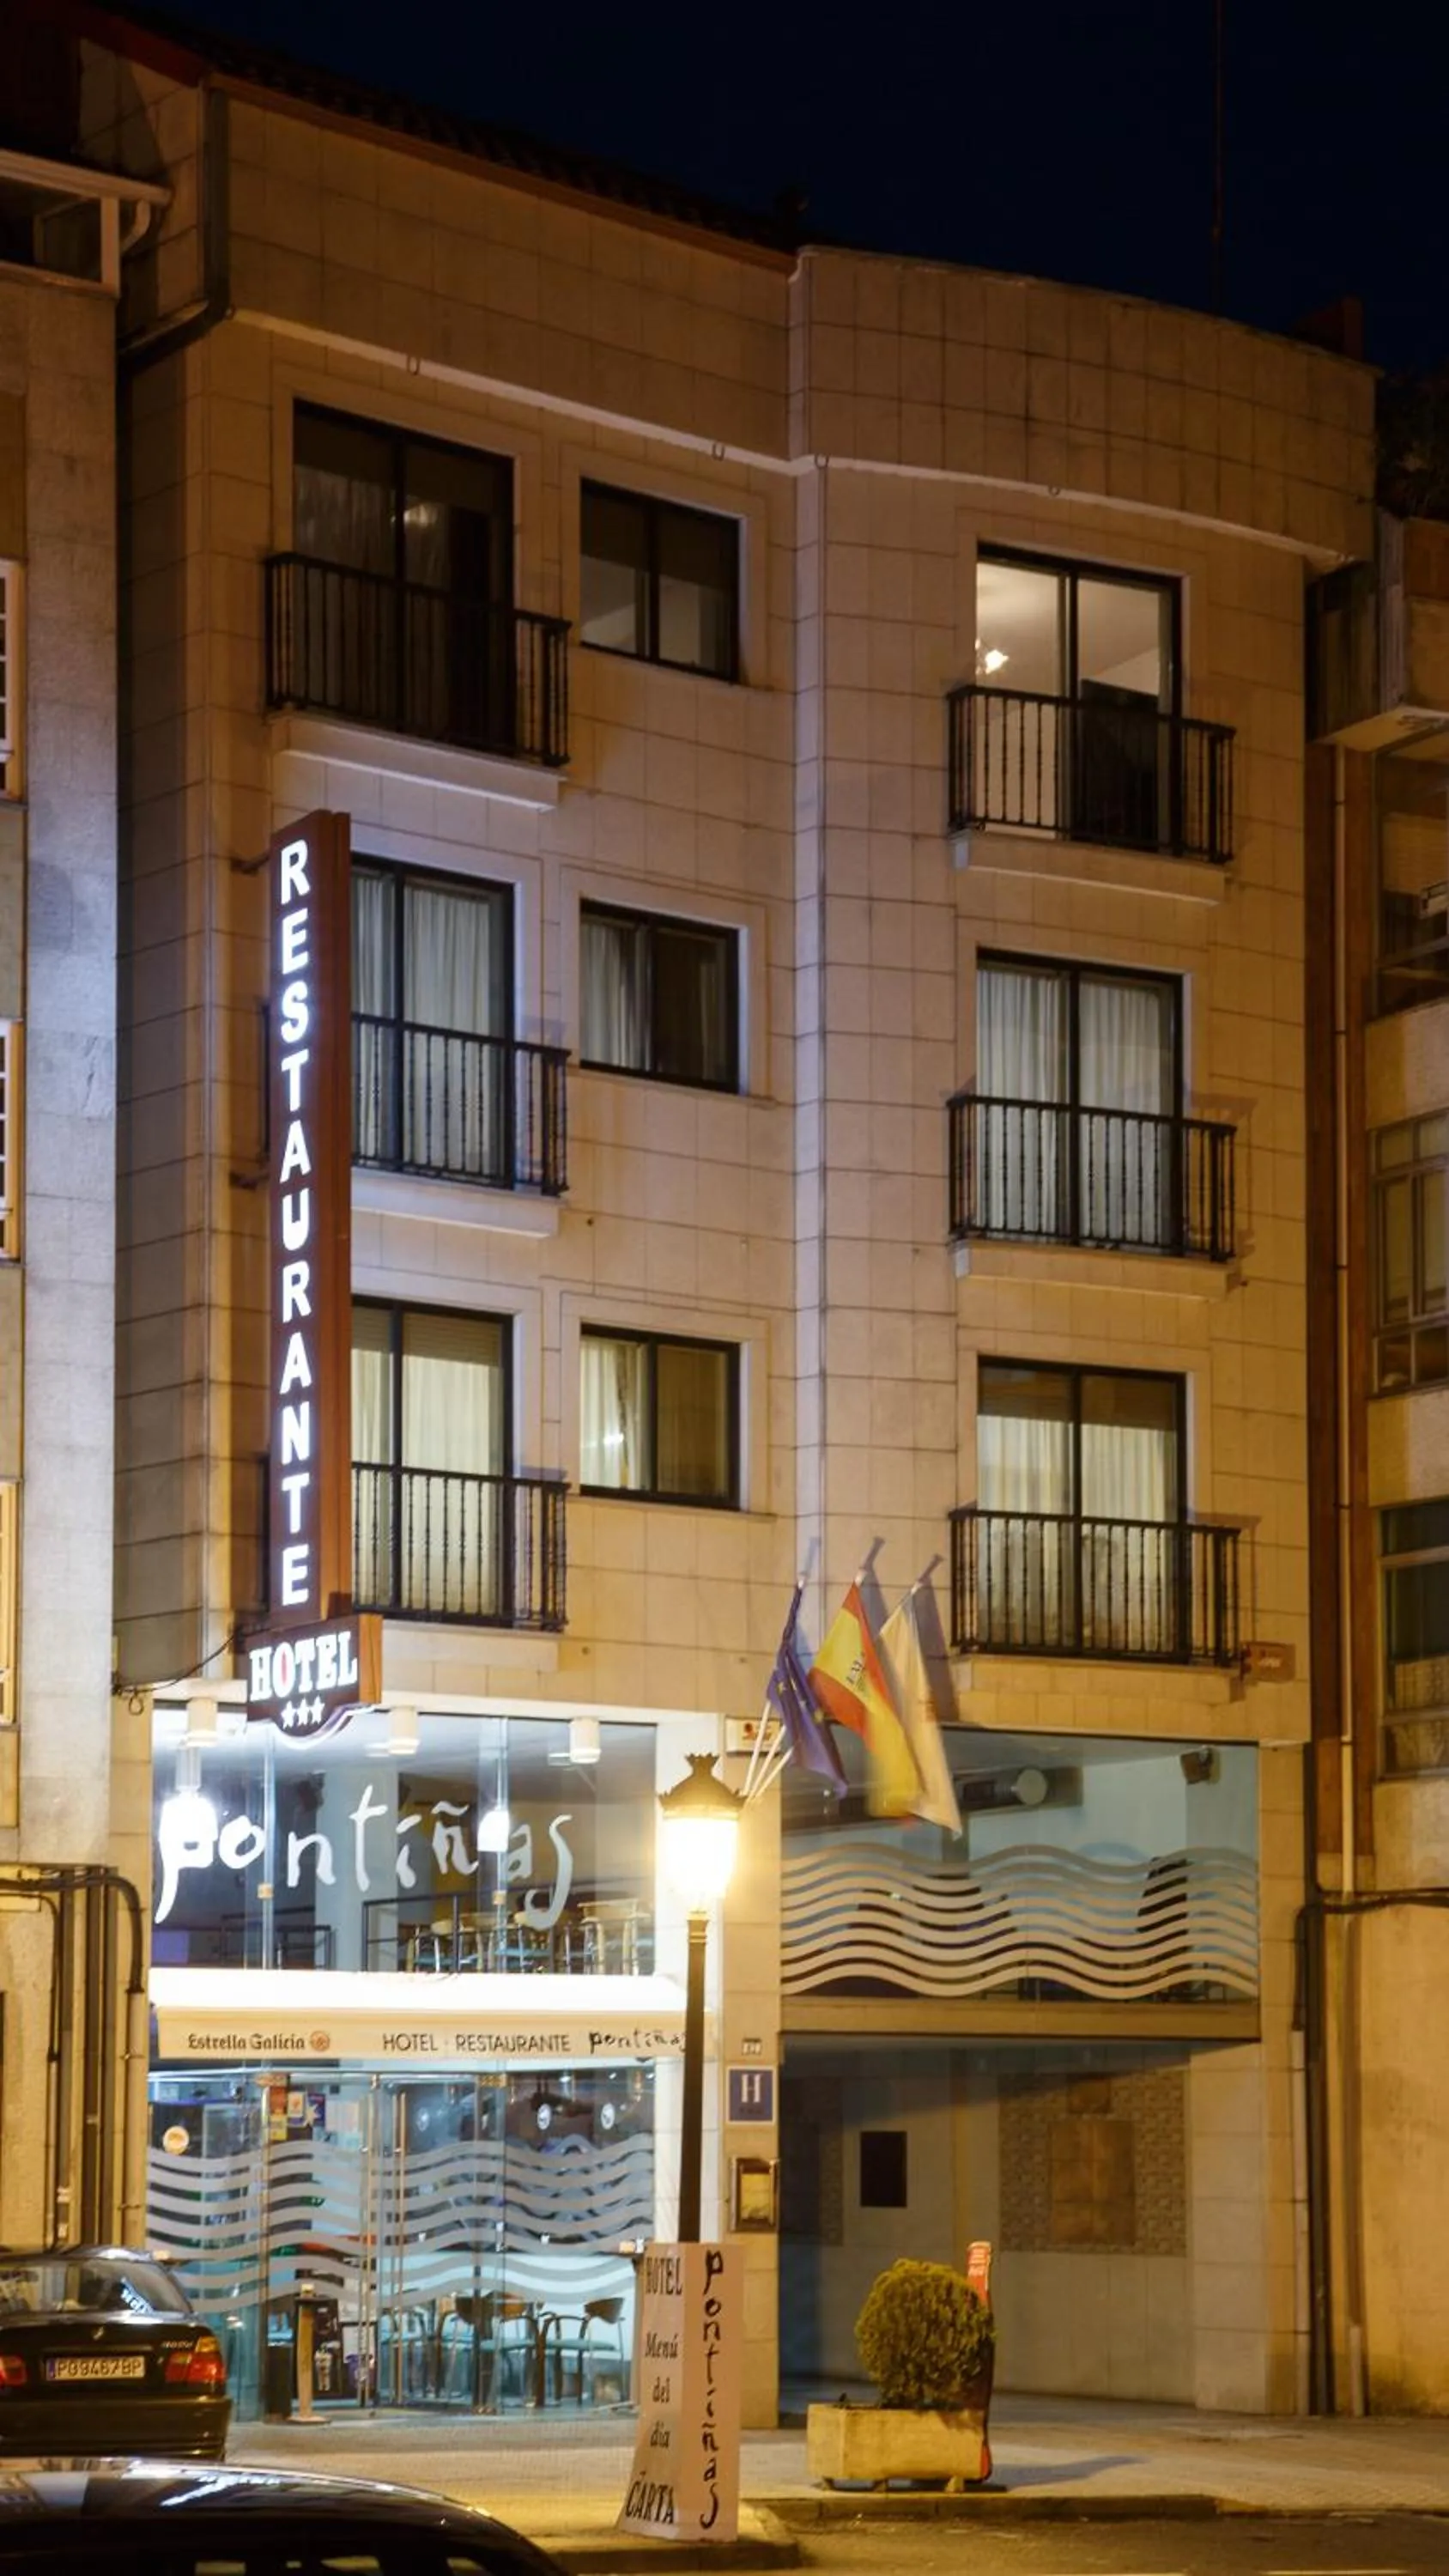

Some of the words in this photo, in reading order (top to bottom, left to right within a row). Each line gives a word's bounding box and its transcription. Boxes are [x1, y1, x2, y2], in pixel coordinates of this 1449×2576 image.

[280, 838, 312, 1607] RESTAURANTE
[249, 1631, 358, 1702] HOTEL
[188, 2032, 246, 2050] Estrella
[250, 2032, 305, 2050] Galicia
[383, 2032, 439, 2051] HOTEL
[456, 2033, 572, 2052] RESTAURANTE
[646, 2257, 683, 2297] HOTEL
[645, 2330, 678, 2359] Menú
[652, 2376, 670, 2403] del
